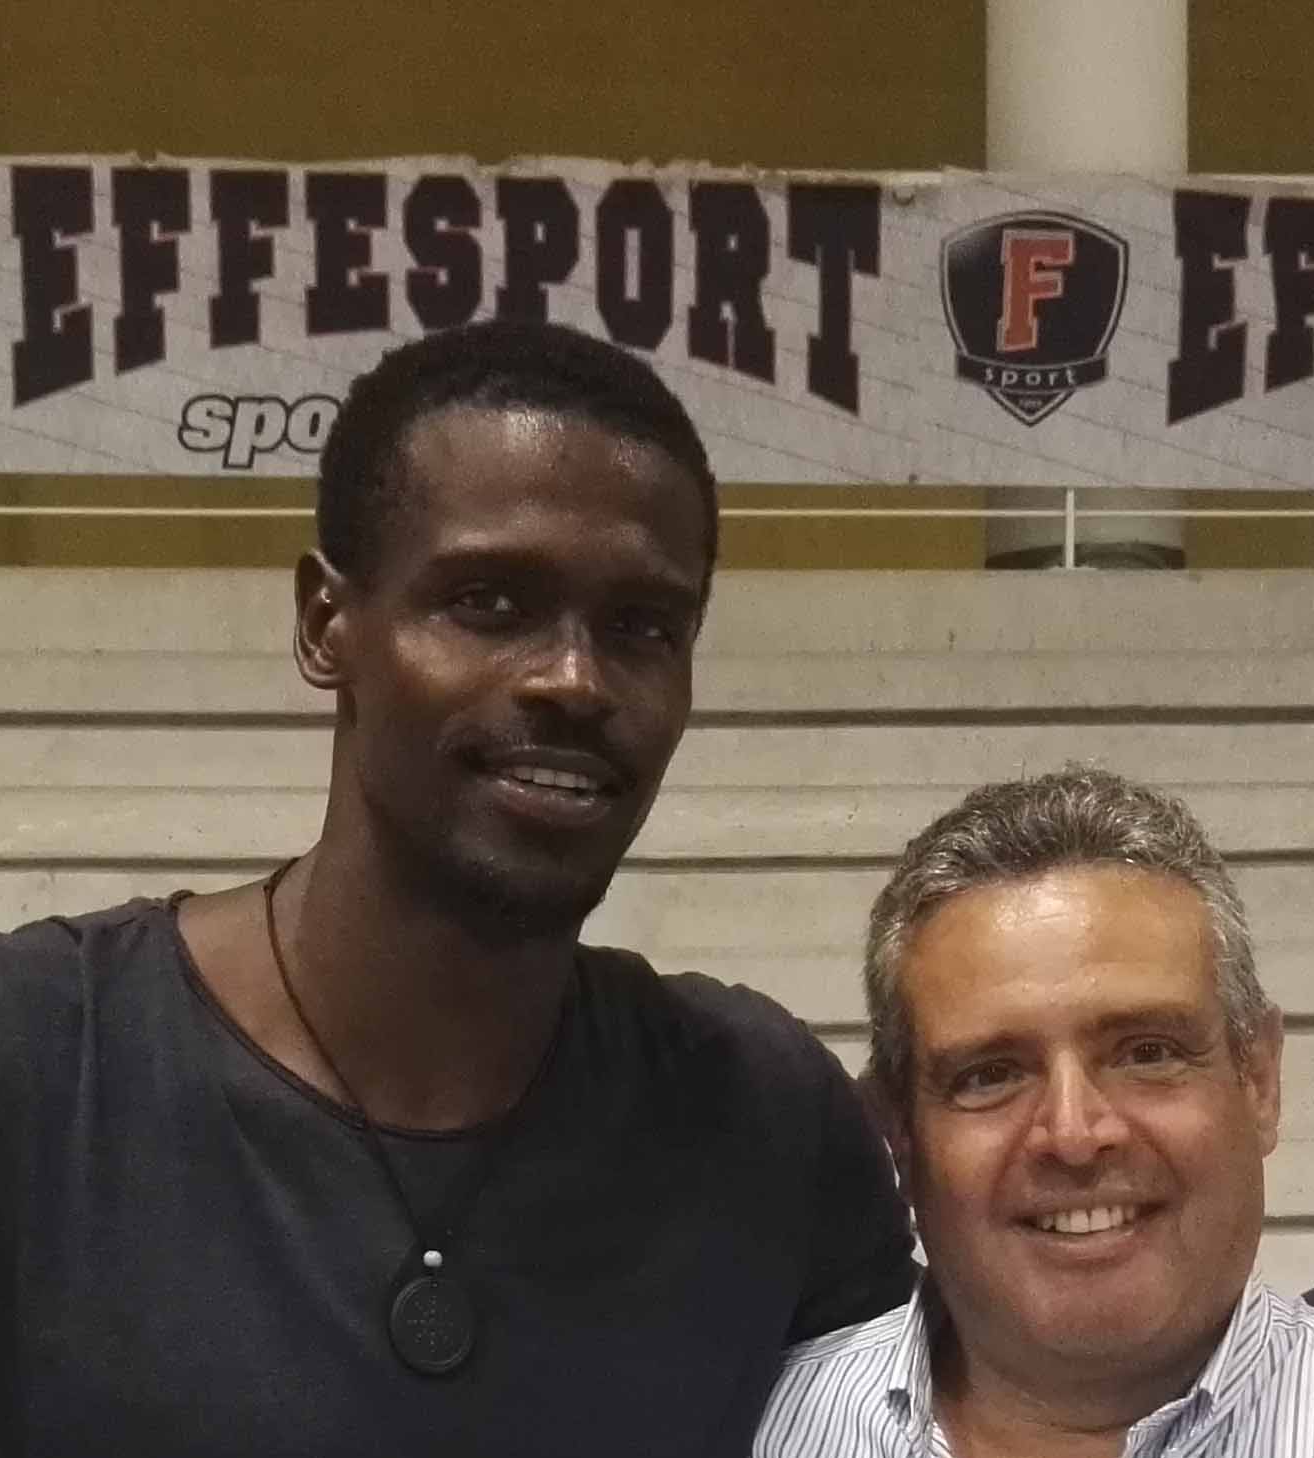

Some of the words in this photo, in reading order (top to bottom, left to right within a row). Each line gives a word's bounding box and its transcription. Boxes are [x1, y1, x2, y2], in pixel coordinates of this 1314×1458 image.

[10, 165, 882, 416] EFFESPORT
[997, 228, 1075, 353] F
[177, 394, 341, 469] spo
